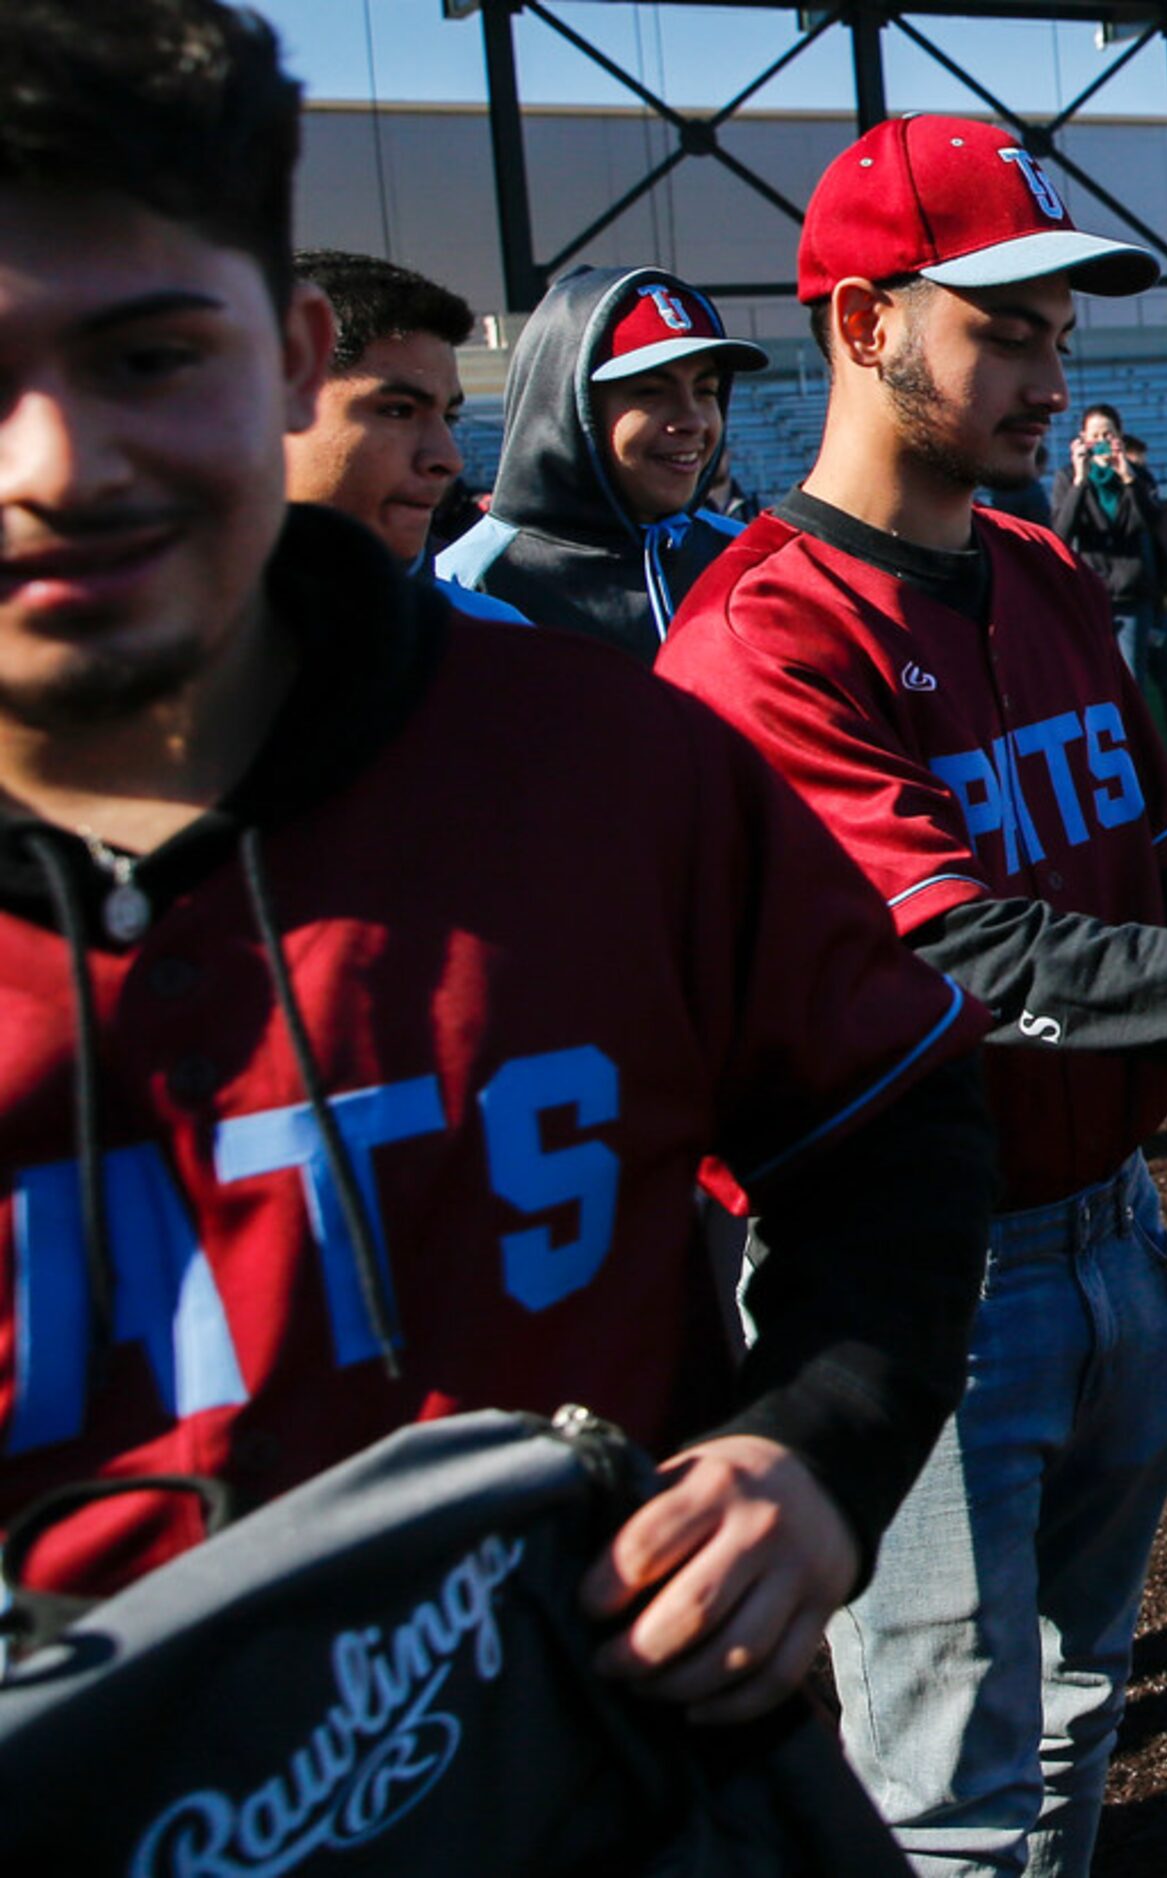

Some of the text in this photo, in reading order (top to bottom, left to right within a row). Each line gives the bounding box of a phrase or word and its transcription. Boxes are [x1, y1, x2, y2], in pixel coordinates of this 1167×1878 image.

[637, 283, 694, 331] TJ
[928, 702, 1146, 877] PATS
[128, 1534, 526, 1878] Rawlings
